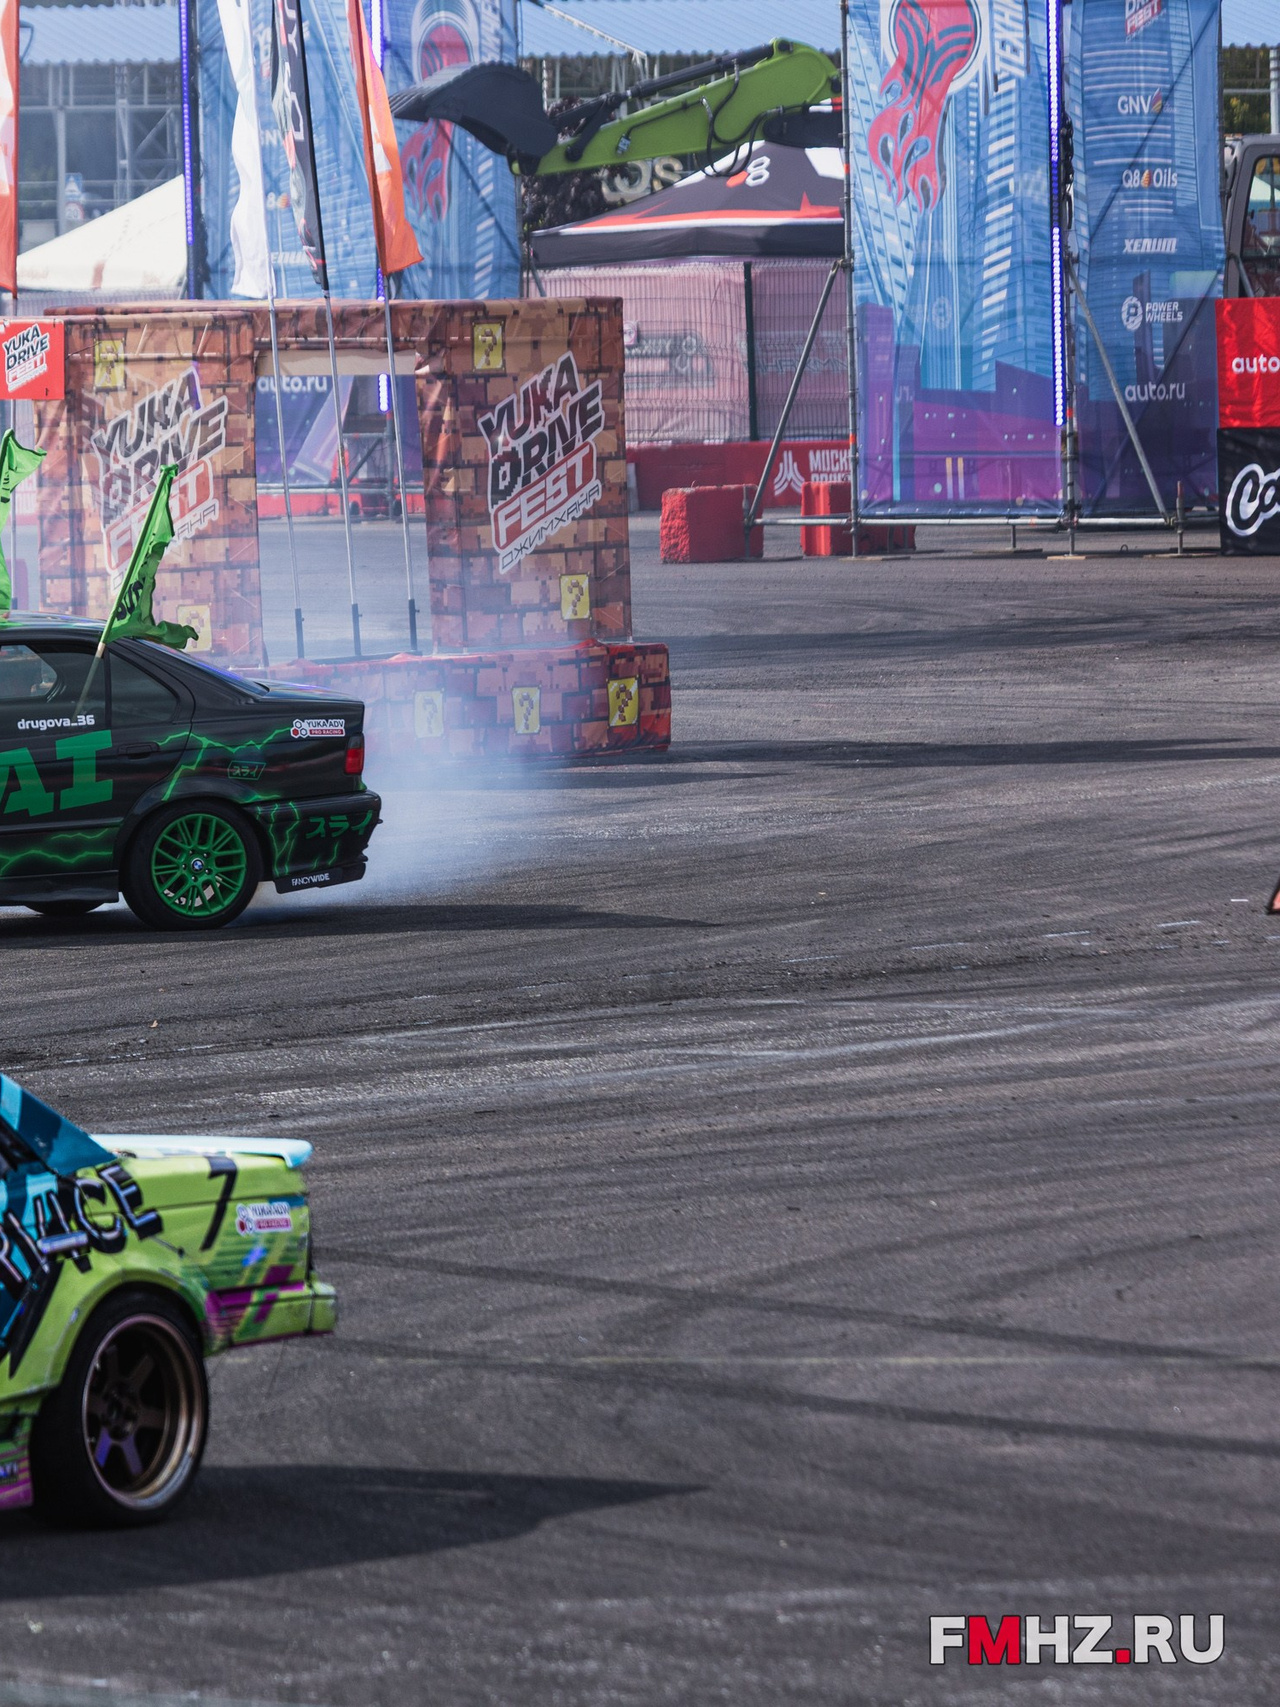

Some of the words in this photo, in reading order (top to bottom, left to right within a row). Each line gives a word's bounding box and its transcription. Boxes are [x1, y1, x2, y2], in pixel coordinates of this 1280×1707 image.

[1118, 95, 1151, 114] GNV
[1122, 169, 1140, 189] Q8
[1153, 168, 1178, 188] Oils
[1146, 302, 1179, 313] POWER
[1146, 312, 1183, 323] WHEELS
[4, 325, 40, 355] YUKA
[7, 335, 49, 370] DRIVE
[1125, 382, 1186, 403] auto.ru
[481, 355, 579, 457] YUKA
[491, 384, 602, 510] DRIVE
[497, 445, 590, 548] FEST
[17, 714, 95, 731] drugova_36
[306, 720, 326, 728] YUKA
[328, 720, 344, 728] ADV
[291, 873, 330, 886] FANCYWIDE
[200, 1156, 238, 1252] 7
